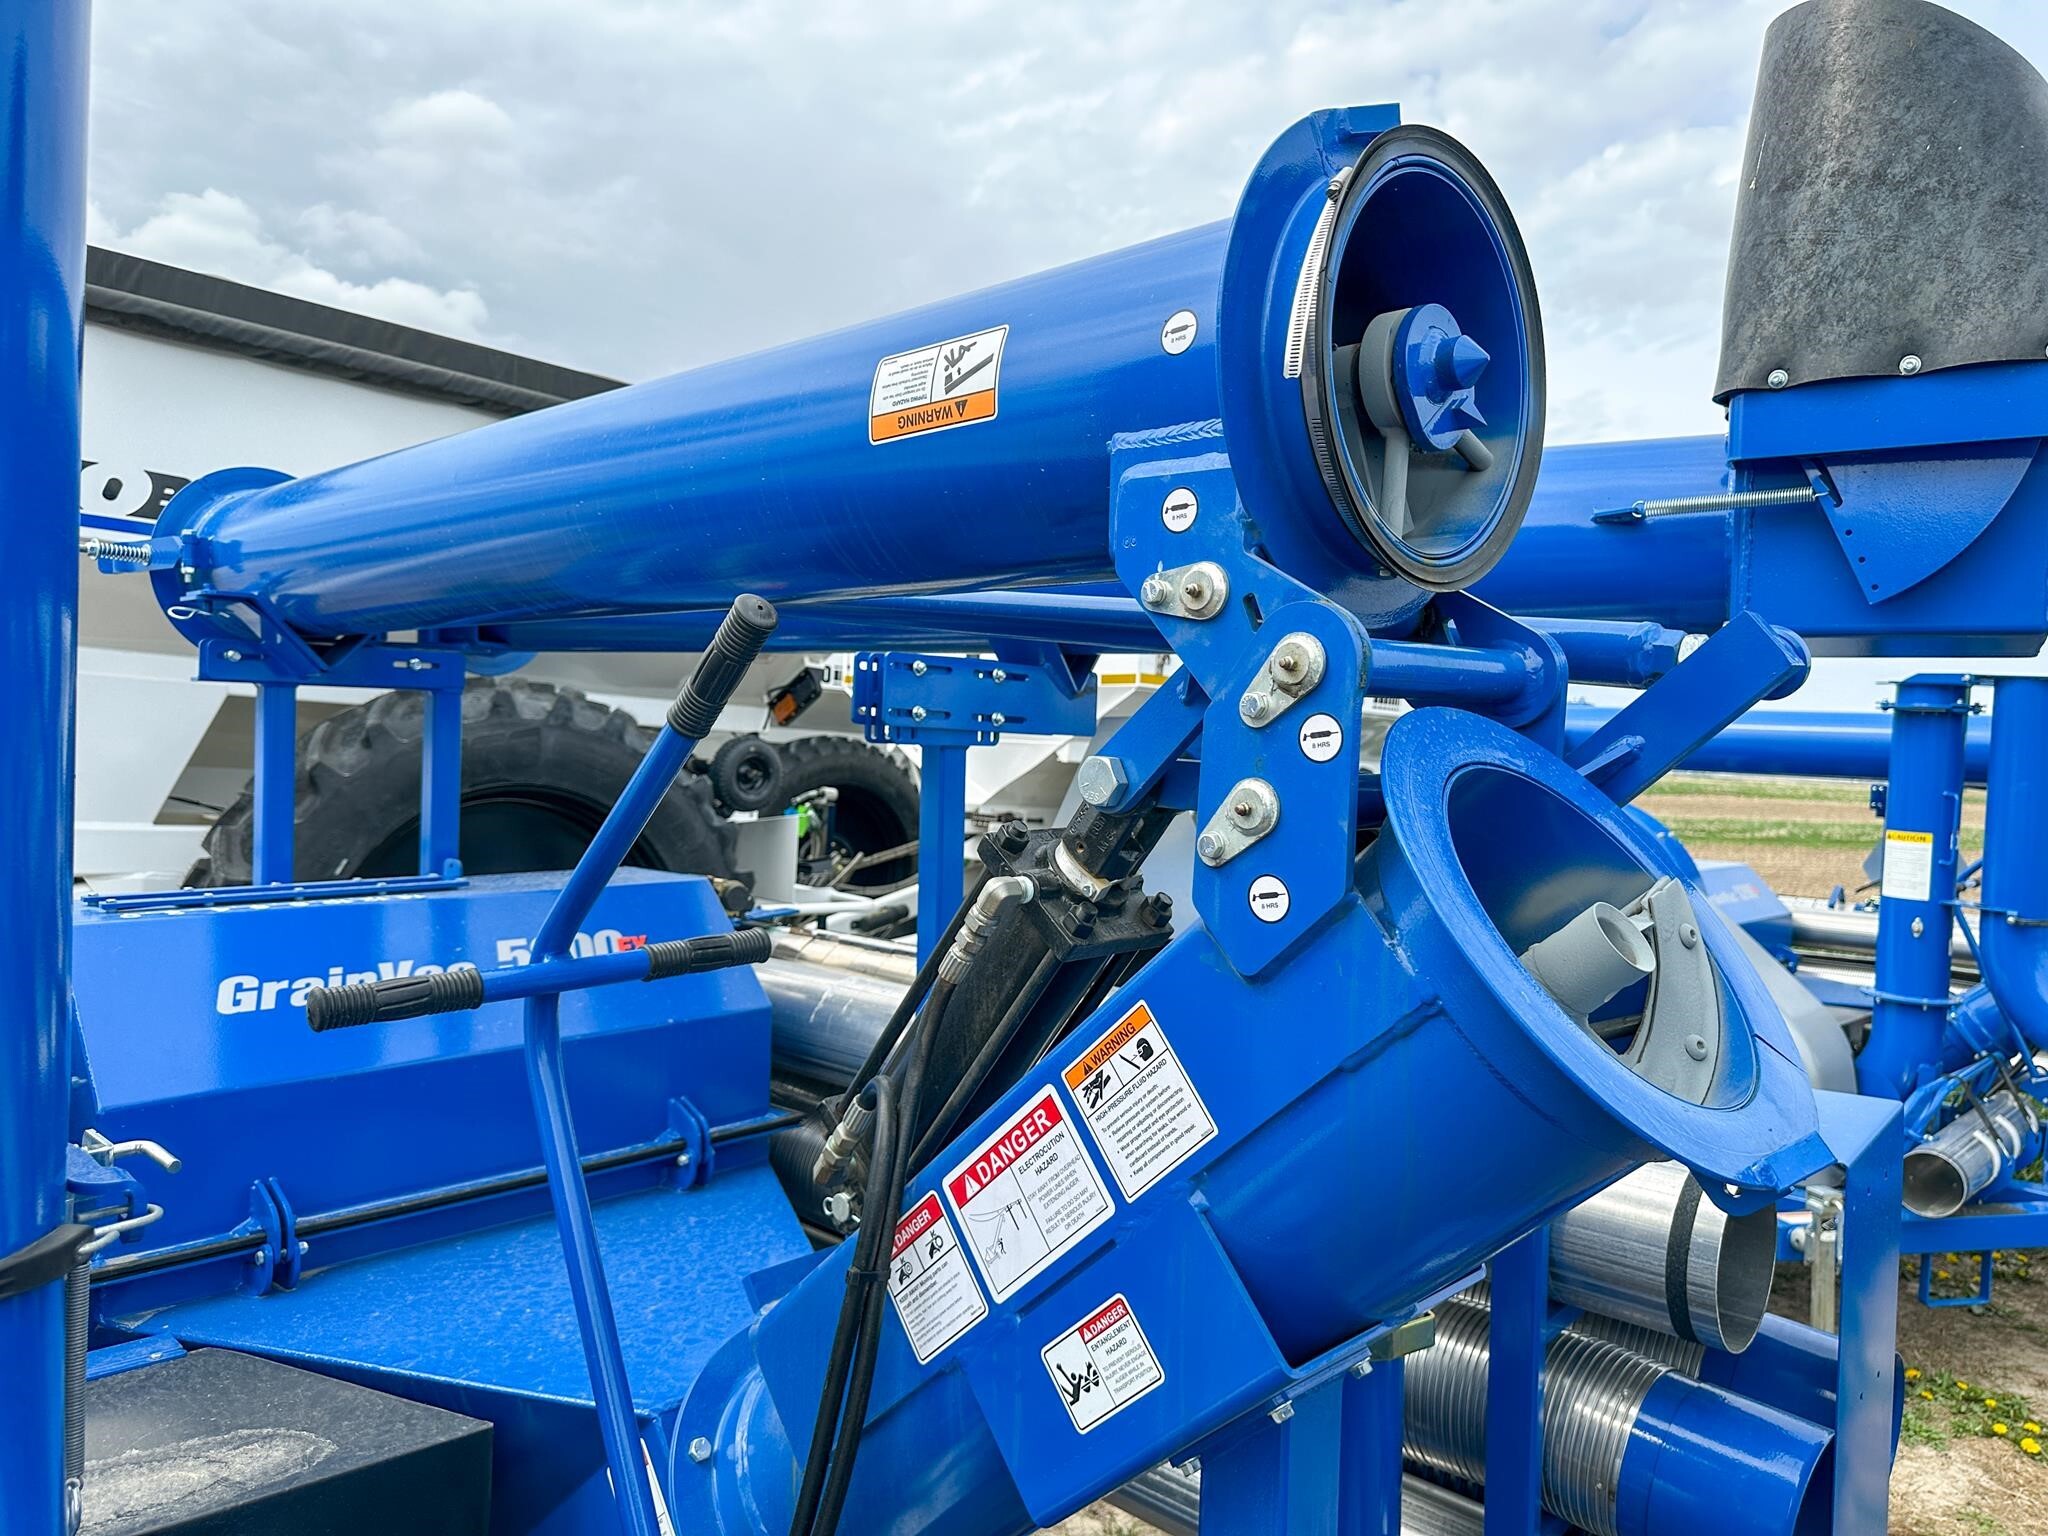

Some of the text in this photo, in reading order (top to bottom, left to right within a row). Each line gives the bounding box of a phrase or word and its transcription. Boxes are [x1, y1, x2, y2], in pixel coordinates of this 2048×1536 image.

[892, 397, 909, 406] HAZARD
[896, 404, 953, 429] WARNING
[1176, 512, 1188, 520] HRS
[216, 929, 648, 1015] GrainV 500EX
[1090, 1020, 1136, 1066] WARNING
[1094, 1057, 1167, 1122] HIGH-PRESSURE FLUID HAZARD
[1105, 1115, 1120, 1130] prevent
[1119, 1104, 1133, 1118] serious
[1131, 1096, 1142, 1108] injury
[1111, 1122, 1125, 1136] Relieve
[1124, 1109, 1140, 1125] pressure
[1145, 1094, 1158, 1108] system
[1157, 1084, 1170, 1097] before
[1115, 1128, 1132, 1144] repairing
[1135, 1111, 1153, 1128] adjusting
[1120, 1096, 1184, 1152] Wear proper hand and eye protection
[974, 1105, 1052, 1185] DANGER
[1124, 1148, 1135, 1159] when
[1134, 1134, 1152, 1151] searching
[1168, 1114, 1177, 1124] Use
[1175, 1105, 1187, 1117] wood
[1017, 1130, 1065, 1175] ELECTROCUTION
[1034, 1151, 1059, 1176] HAZARD
[1128, 1149, 1148, 1168] cardboard
[1146, 1139, 1161, 1153] instead
[1132, 1164, 1143, 1176] Keep
[1147, 1142, 1170, 1164] components
[1173, 1131, 1184, 1143] good
[1026, 1153, 1081, 1201] STAY AWAY FROM OVERHEAD
[1038, 1168, 1076, 1202] POWER LINES WHEN
[1043, 1176, 1079, 1209] EXTENDING AUGER
[1045, 1185, 1089, 1225] FAILURE TO DO SO MAY
[1045, 1219, 1061, 1235] RESULT
[1059, 1215, 1065, 1223] IN
[1064, 1202, 1082, 1219] SERIOUS
[1081, 1190, 1096, 1205] INJURY
[1063, 1210, 1085, 1230] OR DEATH
[894, 1208, 932, 1247] DANGER
[1089, 1303, 1125, 1335] DANGER
[1090, 1319, 1131, 1352] ENTANGLEMENT
[1104, 1336, 1127, 1356] HAZARD
